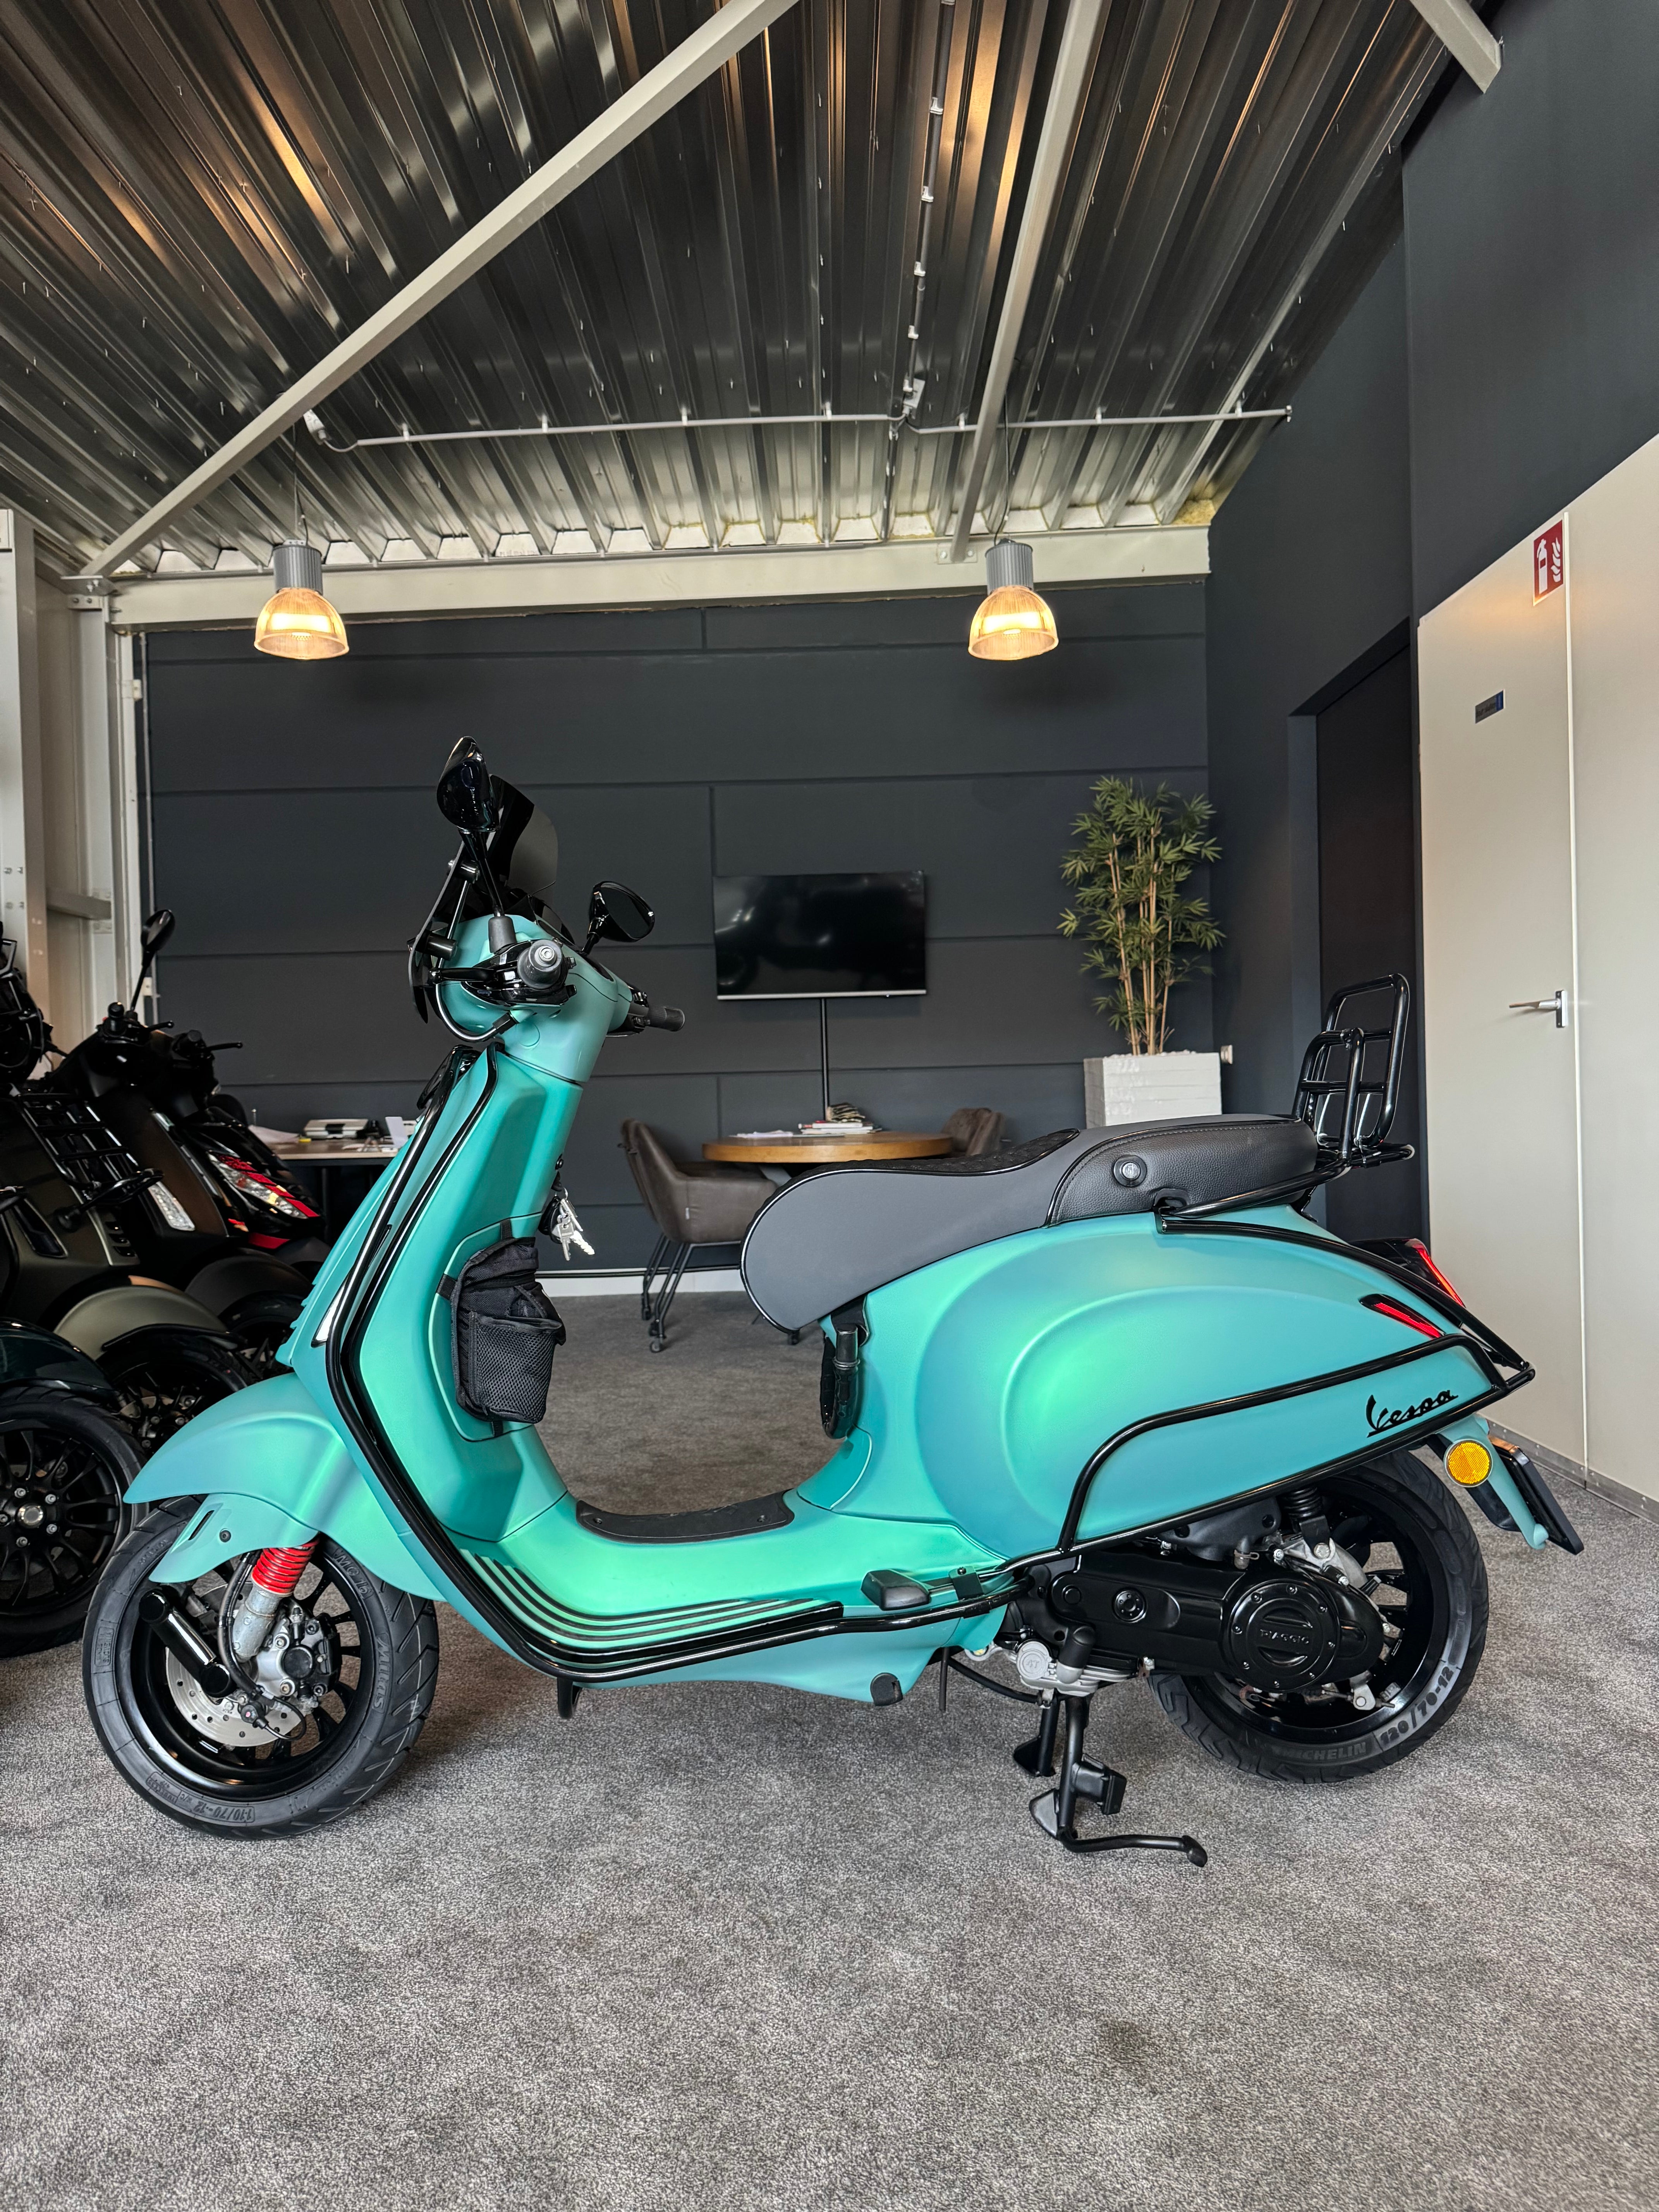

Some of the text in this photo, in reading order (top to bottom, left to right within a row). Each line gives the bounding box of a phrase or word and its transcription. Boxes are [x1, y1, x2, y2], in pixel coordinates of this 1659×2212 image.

[1366, 1389, 1459, 1438] Vespa
[1260, 1629, 1309, 1644] PIAGGIO
[372, 1637, 390, 1709] Mitas
[1025, 1659, 1040, 1669] 4T
[1380, 1666, 1454, 1745] 120/70-12
[1284, 1741, 1366, 1761] MICHELIN
